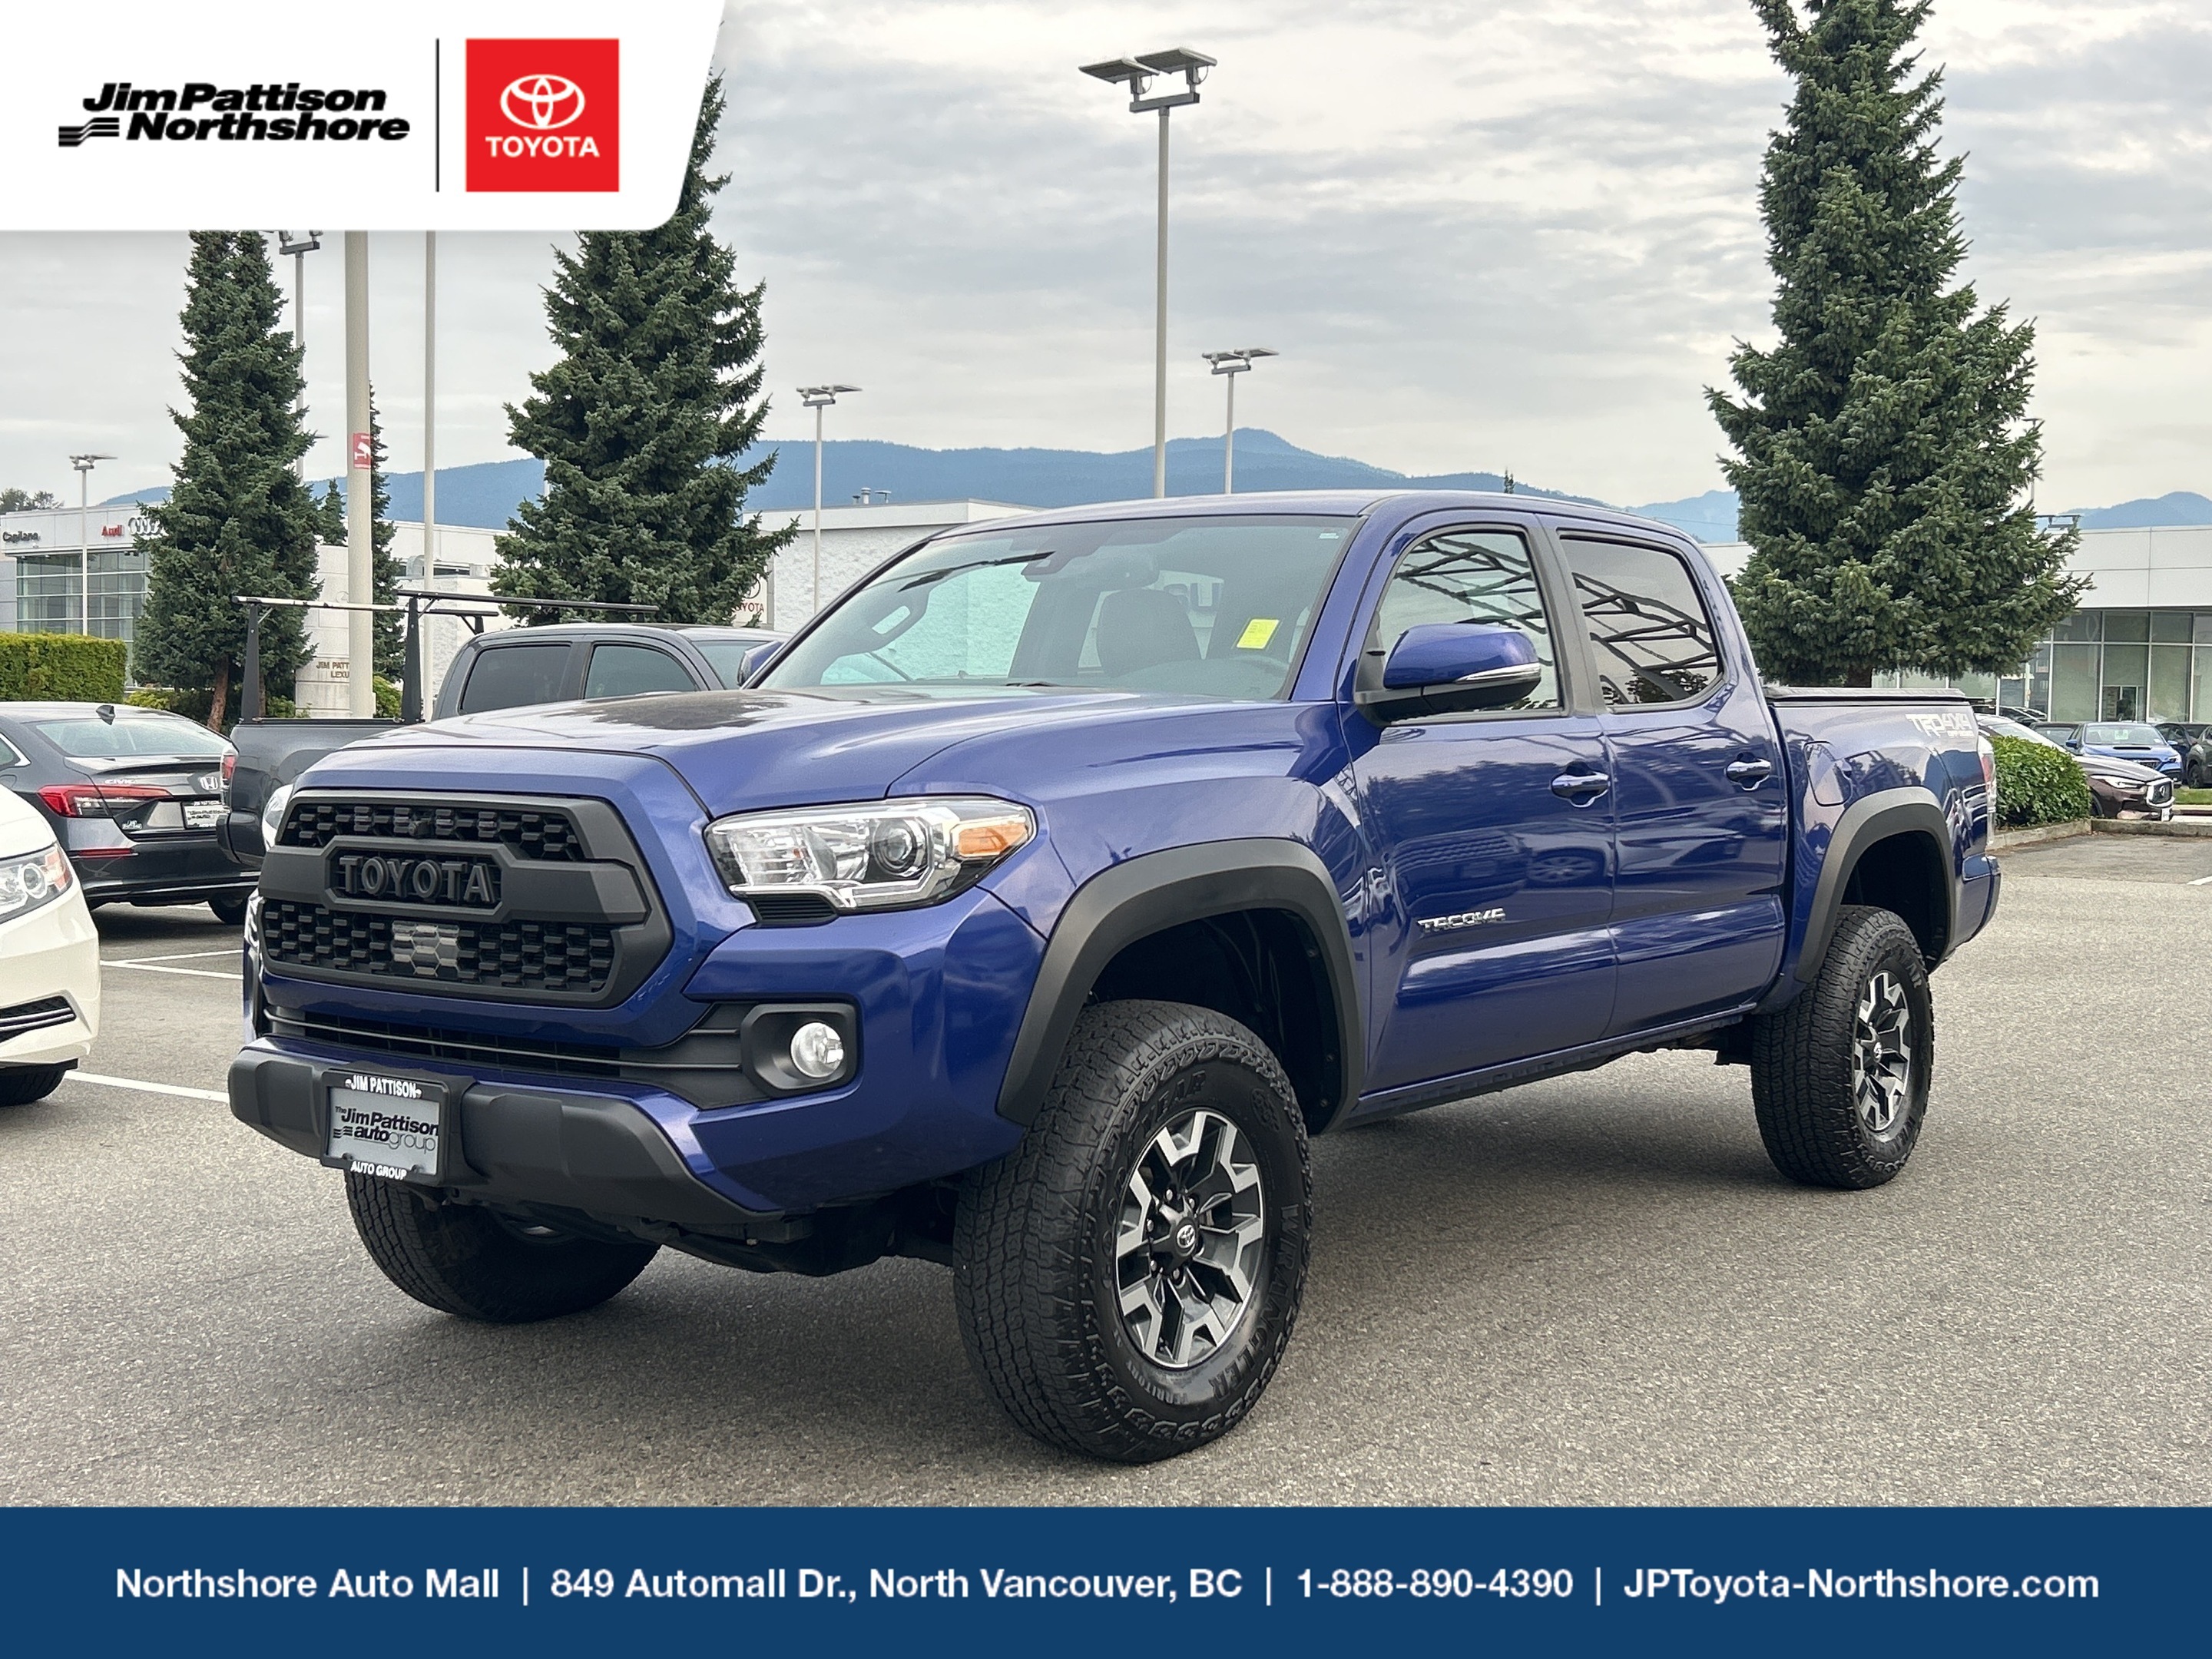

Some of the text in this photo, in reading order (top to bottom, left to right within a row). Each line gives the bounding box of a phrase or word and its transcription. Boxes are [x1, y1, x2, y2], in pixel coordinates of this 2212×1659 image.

[101, 524, 124, 537] Audi
[316, 661, 330, 670] JIM
[339, 855, 496, 904] TOYOTA
[1417, 907, 1507, 933] TACOMA
[350, 1075, 417, 1099] JIM PATTISON
[341, 1107, 439, 1137] Jim Pattison
[350, 1161, 408, 1181] AUTO GROUP
